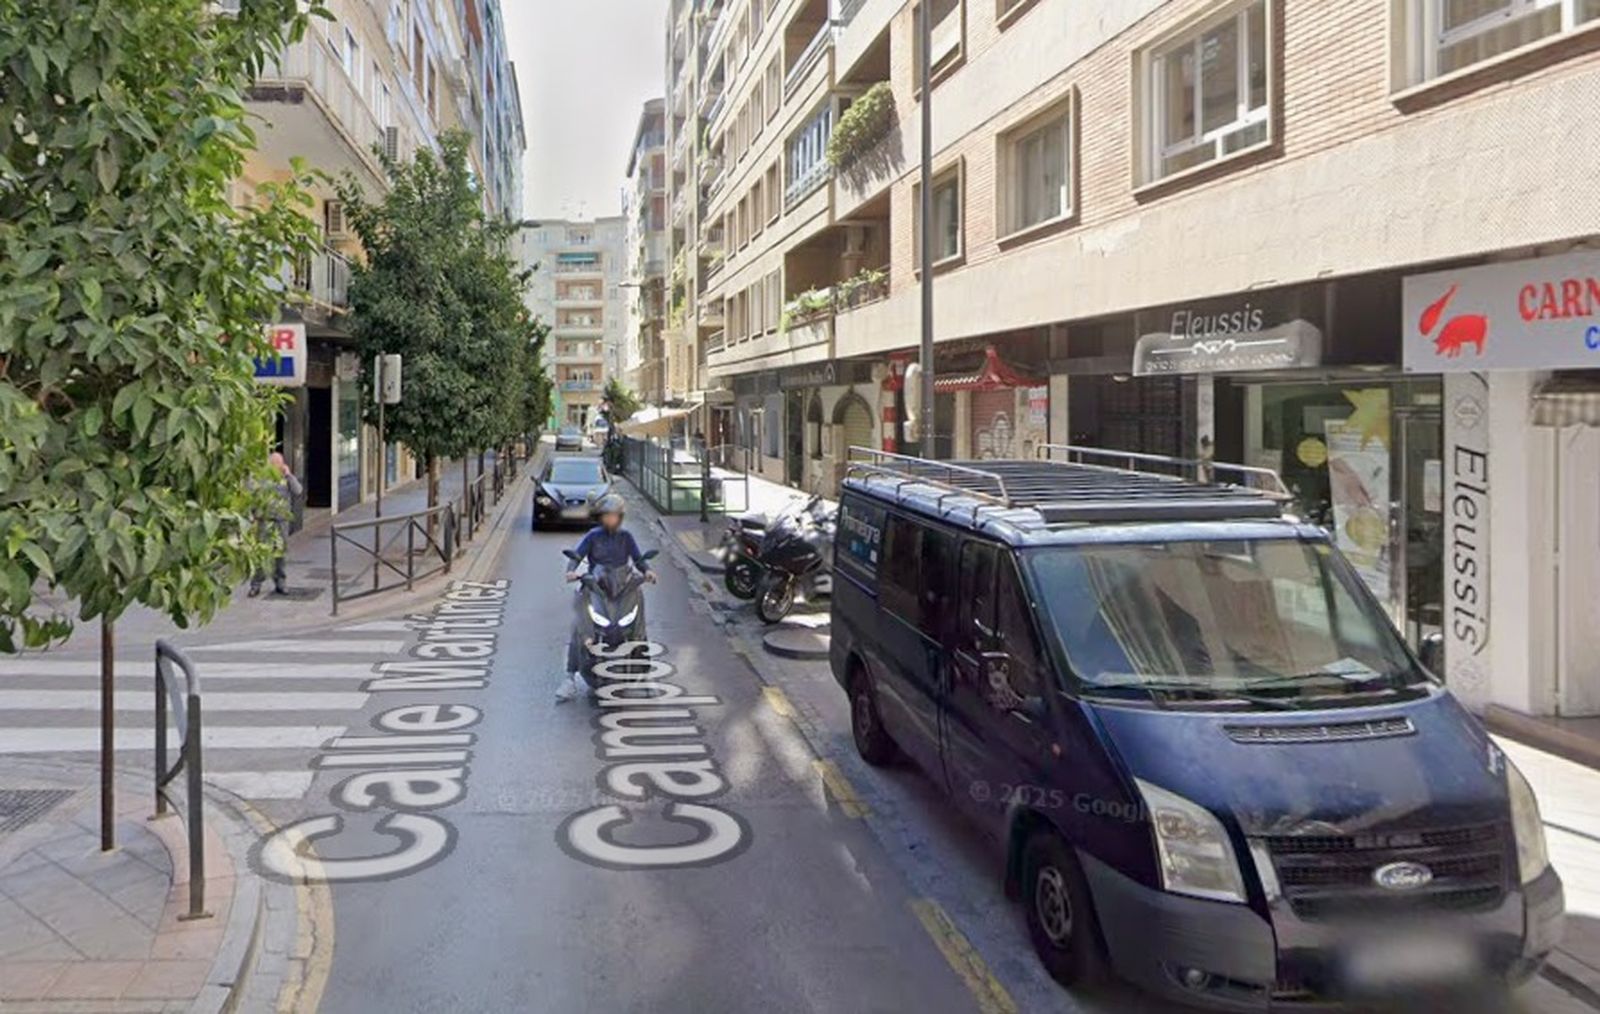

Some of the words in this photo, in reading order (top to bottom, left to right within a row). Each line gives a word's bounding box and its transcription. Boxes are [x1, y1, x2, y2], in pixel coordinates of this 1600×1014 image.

[1169, 303, 1264, 340] Eleussis
[1518, 278, 1600, 322] CARN
[1453, 444, 1488, 647] Eleussis
